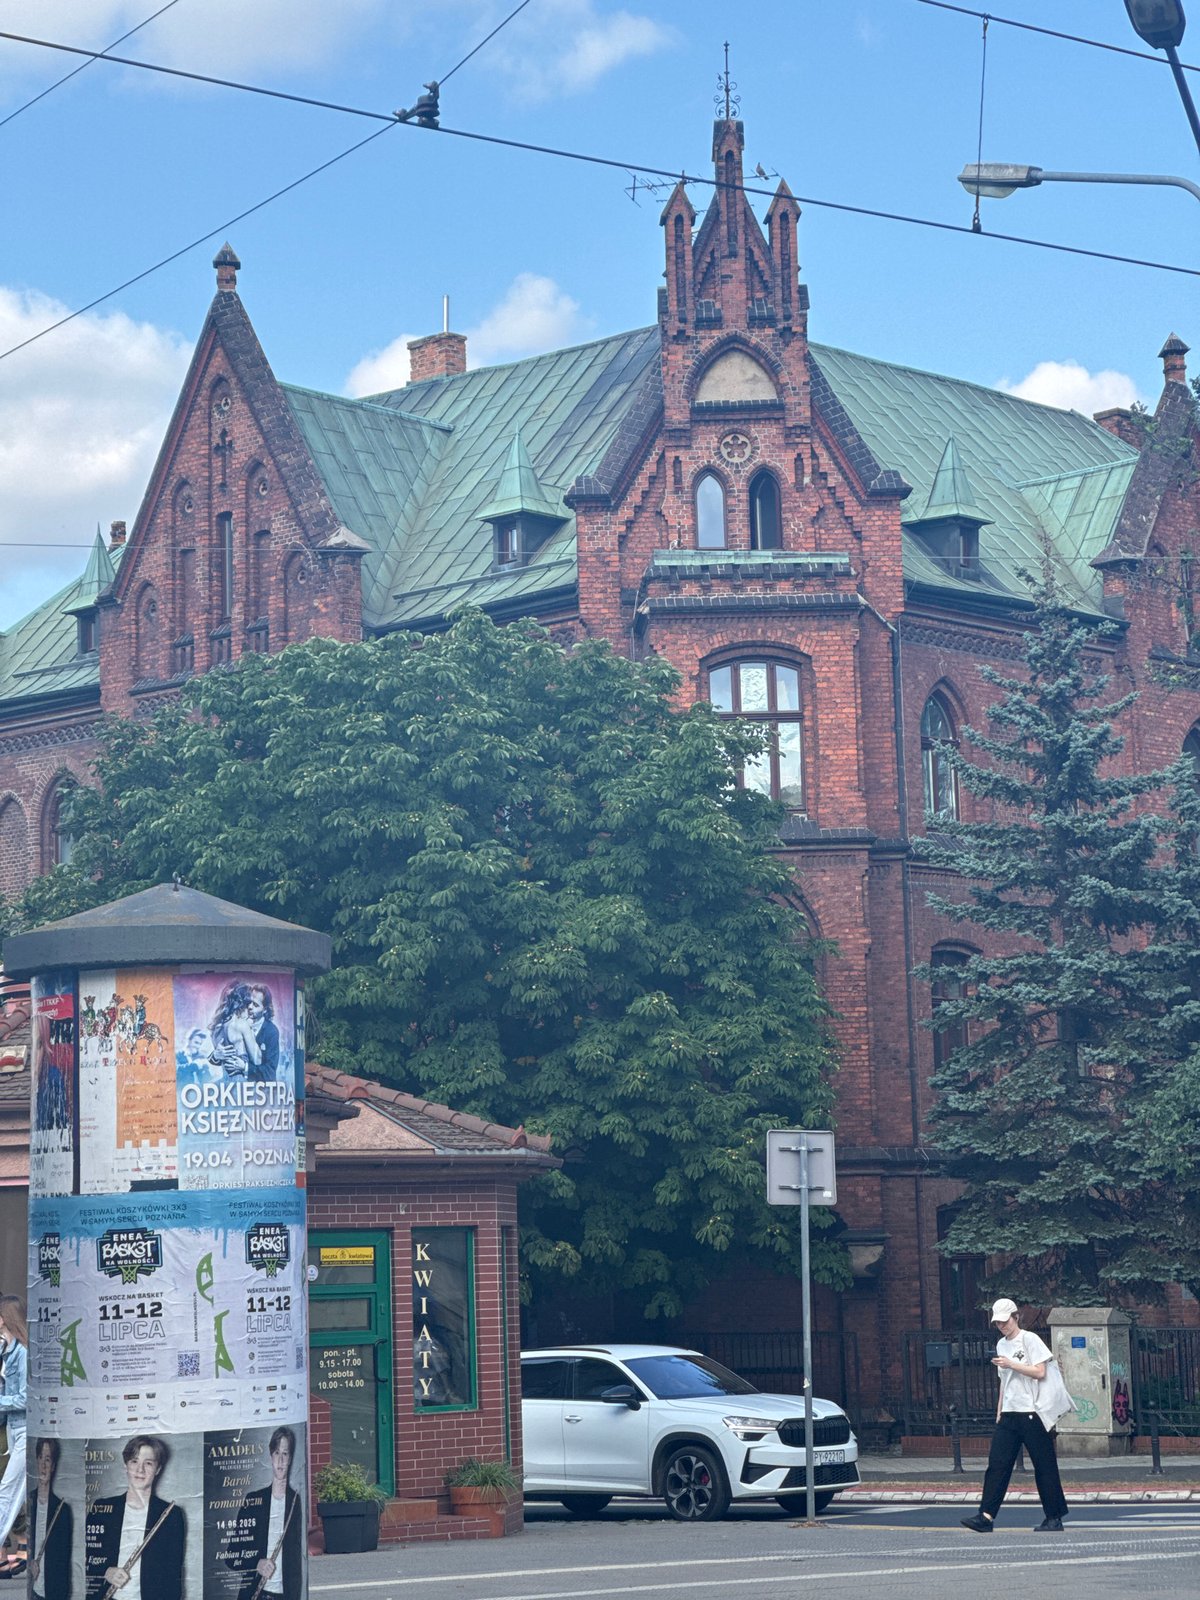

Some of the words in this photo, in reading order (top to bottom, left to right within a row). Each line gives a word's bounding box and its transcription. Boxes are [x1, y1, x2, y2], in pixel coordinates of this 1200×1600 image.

[181, 1081, 295, 1109] ORKIESTRA
[181, 1109, 295, 1137] KSIĘŻNICZEK
[183, 1151, 233, 1168] 19.04
[80, 1208, 115, 1217] FESTIWAL
[116, 1203, 169, 1214] KOSZYKÓWKI
[171, 1203, 187, 1212] 3X3
[112, 1232, 143, 1241] ENEA
[259, 1227, 281, 1235] ENEA
[117, 1257, 154, 1265] WOLNOŚCI
[137, 1291, 164, 1299] BASKET
[247, 1295, 291, 1312] 11-12
[98, 1301, 163, 1320] 11-12
[246, 1313, 292, 1333] LIPCA
[414, 1243, 433, 1396] KWIATY
[98, 1319, 166, 1341] LIPCA
[323, 1350, 340, 1358] pon.
[347, 1348, 357, 1357] pt.
[319, 1359, 335, 1369] 9.15
[342, 1358, 362, 1367] 17.00
[327, 1370, 354, 1379] sobota
[318, 1380, 338, 1390] 10.00
[344, 1379, 365, 1388] 14.00
[208, 1444, 264, 1458] AMADEUS
[222, 1474, 252, 1488] Barok
[232, 1488, 243, 1497] vs
[208, 1497, 263, 1510] romantyzm
[215, 1550, 240, 1560] Fabian
[241, 1549, 259, 1559] Egger
